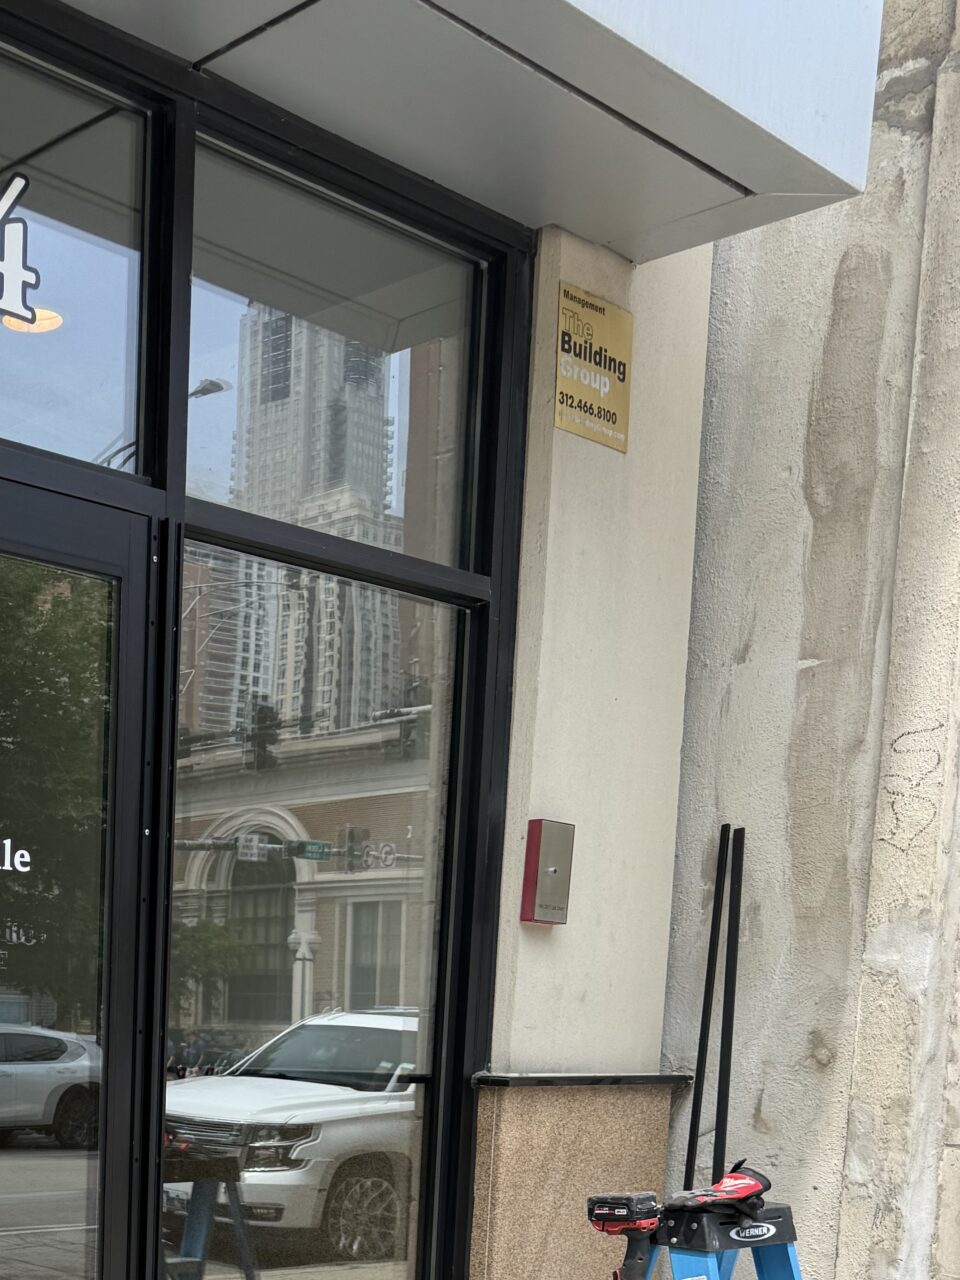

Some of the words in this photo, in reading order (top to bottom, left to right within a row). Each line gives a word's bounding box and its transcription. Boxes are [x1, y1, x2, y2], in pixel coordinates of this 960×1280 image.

[563, 288, 606, 316] Management
[561, 307, 593, 340] The
[560, 331, 627, 383] Building
[559, 355, 610, 397] Group
[558, 391, 618, 425] 312.466.8100
